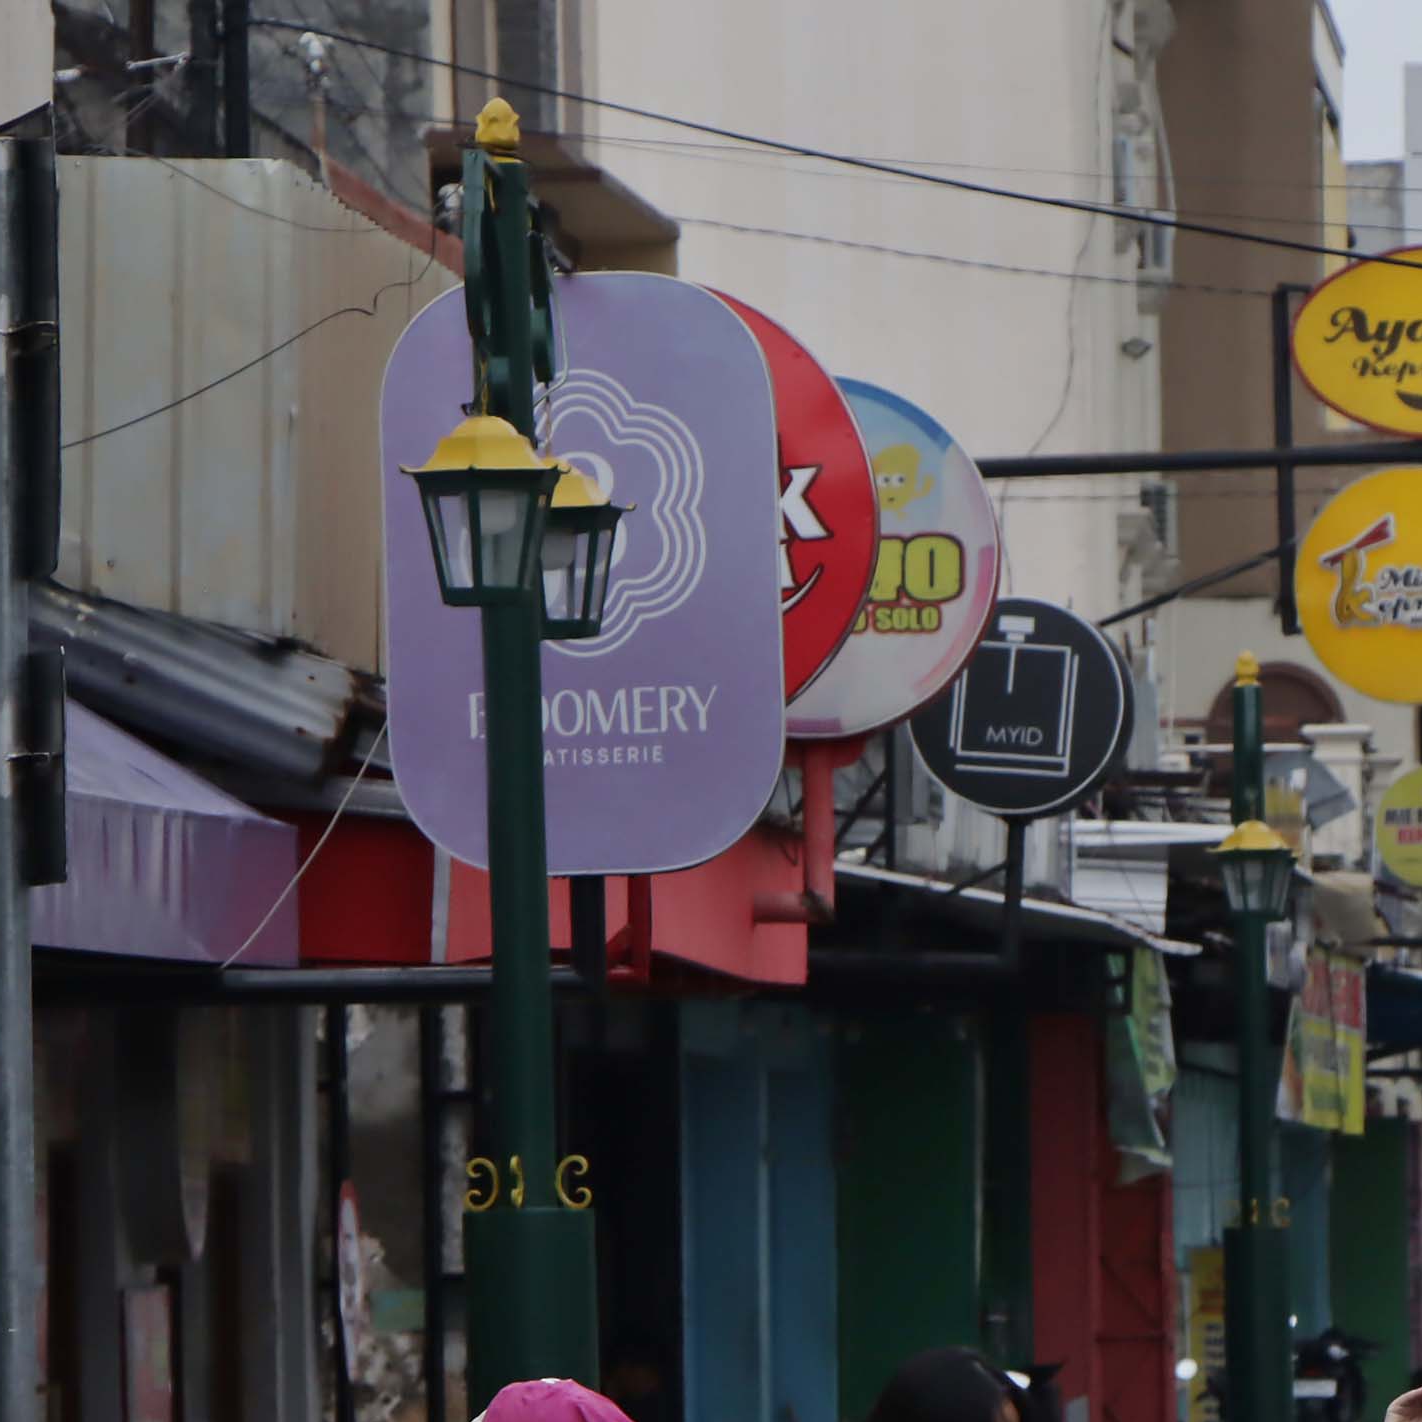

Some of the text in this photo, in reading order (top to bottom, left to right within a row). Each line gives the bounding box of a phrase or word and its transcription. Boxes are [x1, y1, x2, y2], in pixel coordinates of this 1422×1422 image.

[873, 603, 942, 634] SOLO
[468, 685, 718, 739] BOMERY
[985, 725, 1044, 748] MYID
[543, 745, 665, 767] ATISSERIE
